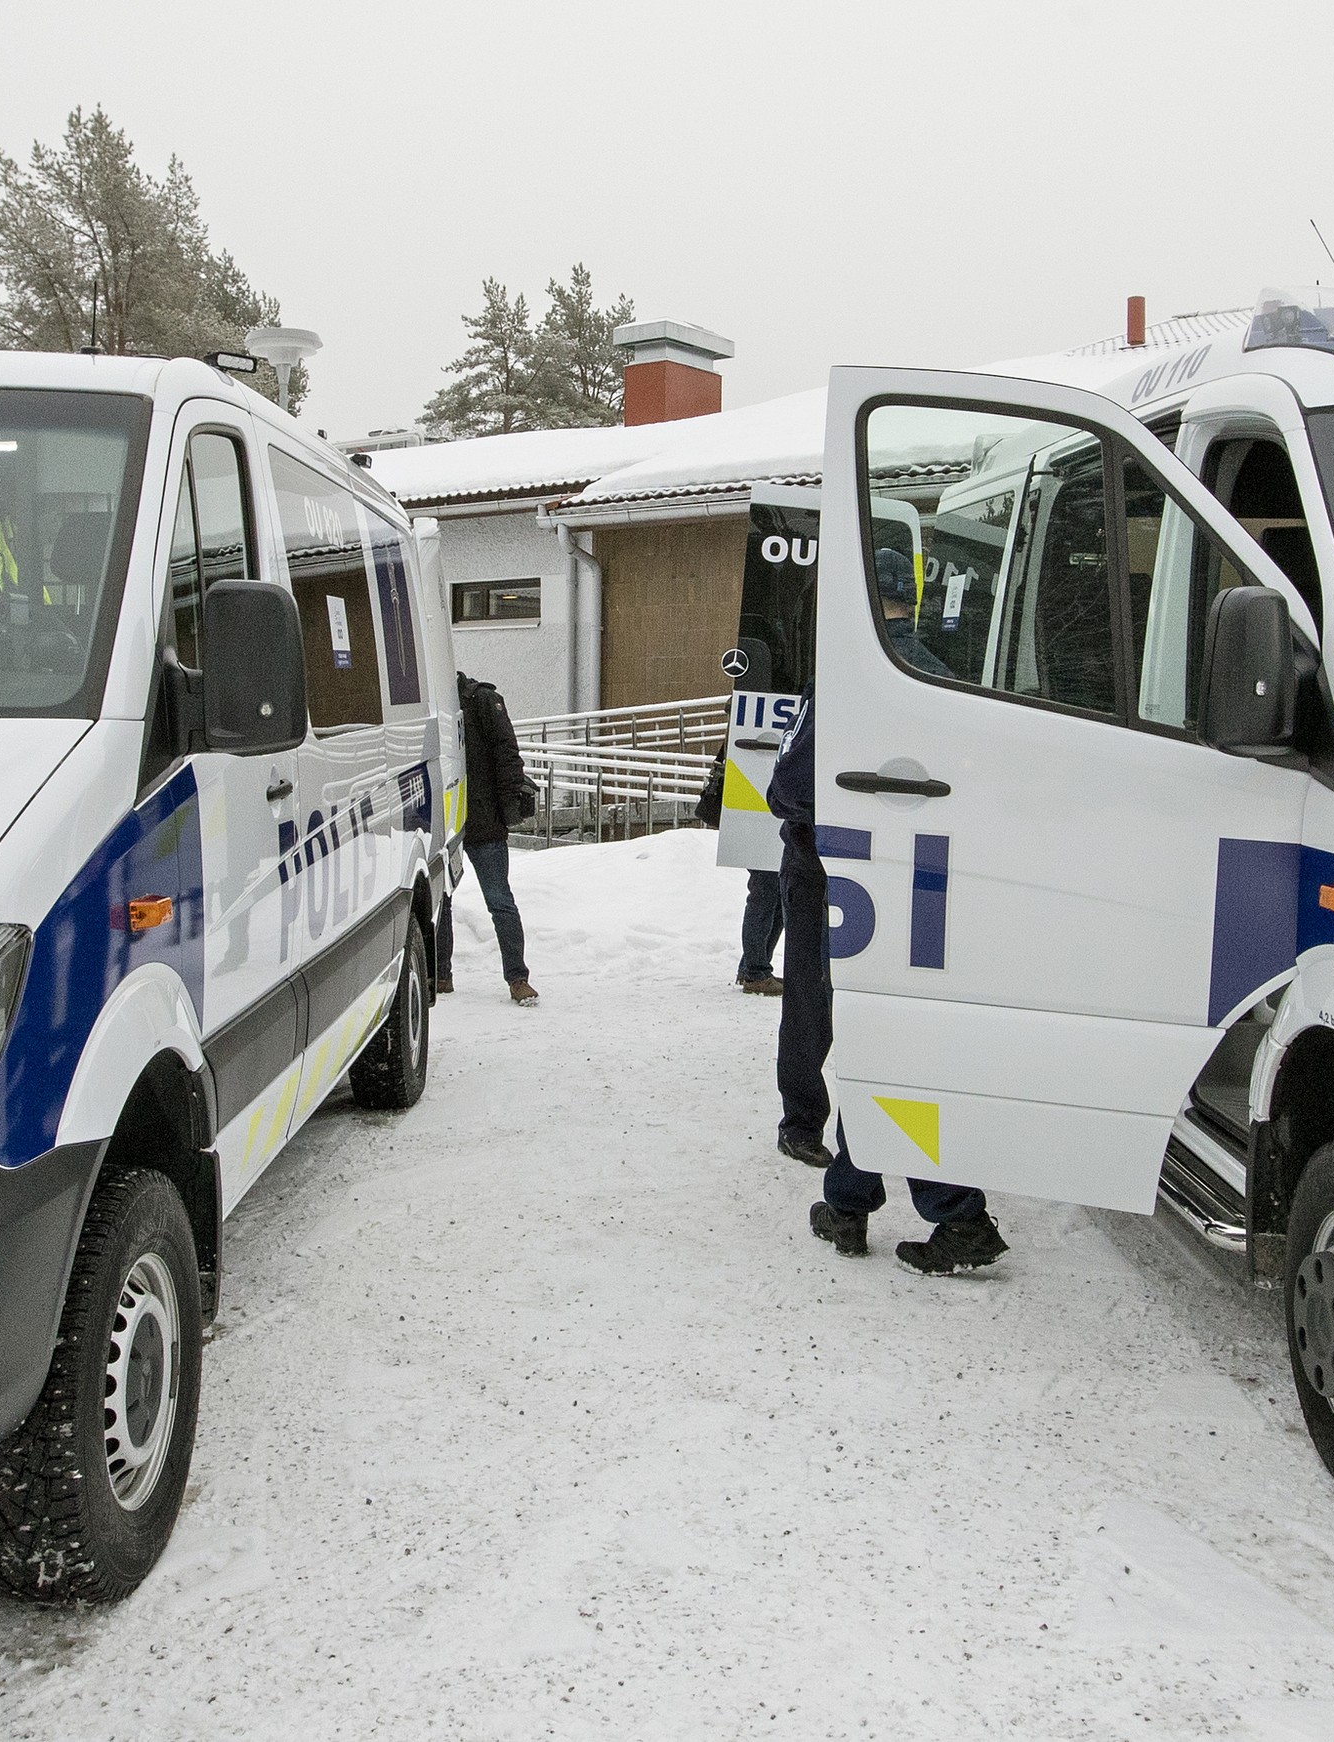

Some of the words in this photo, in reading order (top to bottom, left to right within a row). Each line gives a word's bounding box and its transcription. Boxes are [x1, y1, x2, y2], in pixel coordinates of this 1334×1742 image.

[1131, 361, 1169, 403] OU
[1165, 344, 1213, 389] 110
[304, 496, 324, 541] OU
[761, 535, 818, 566] OU
